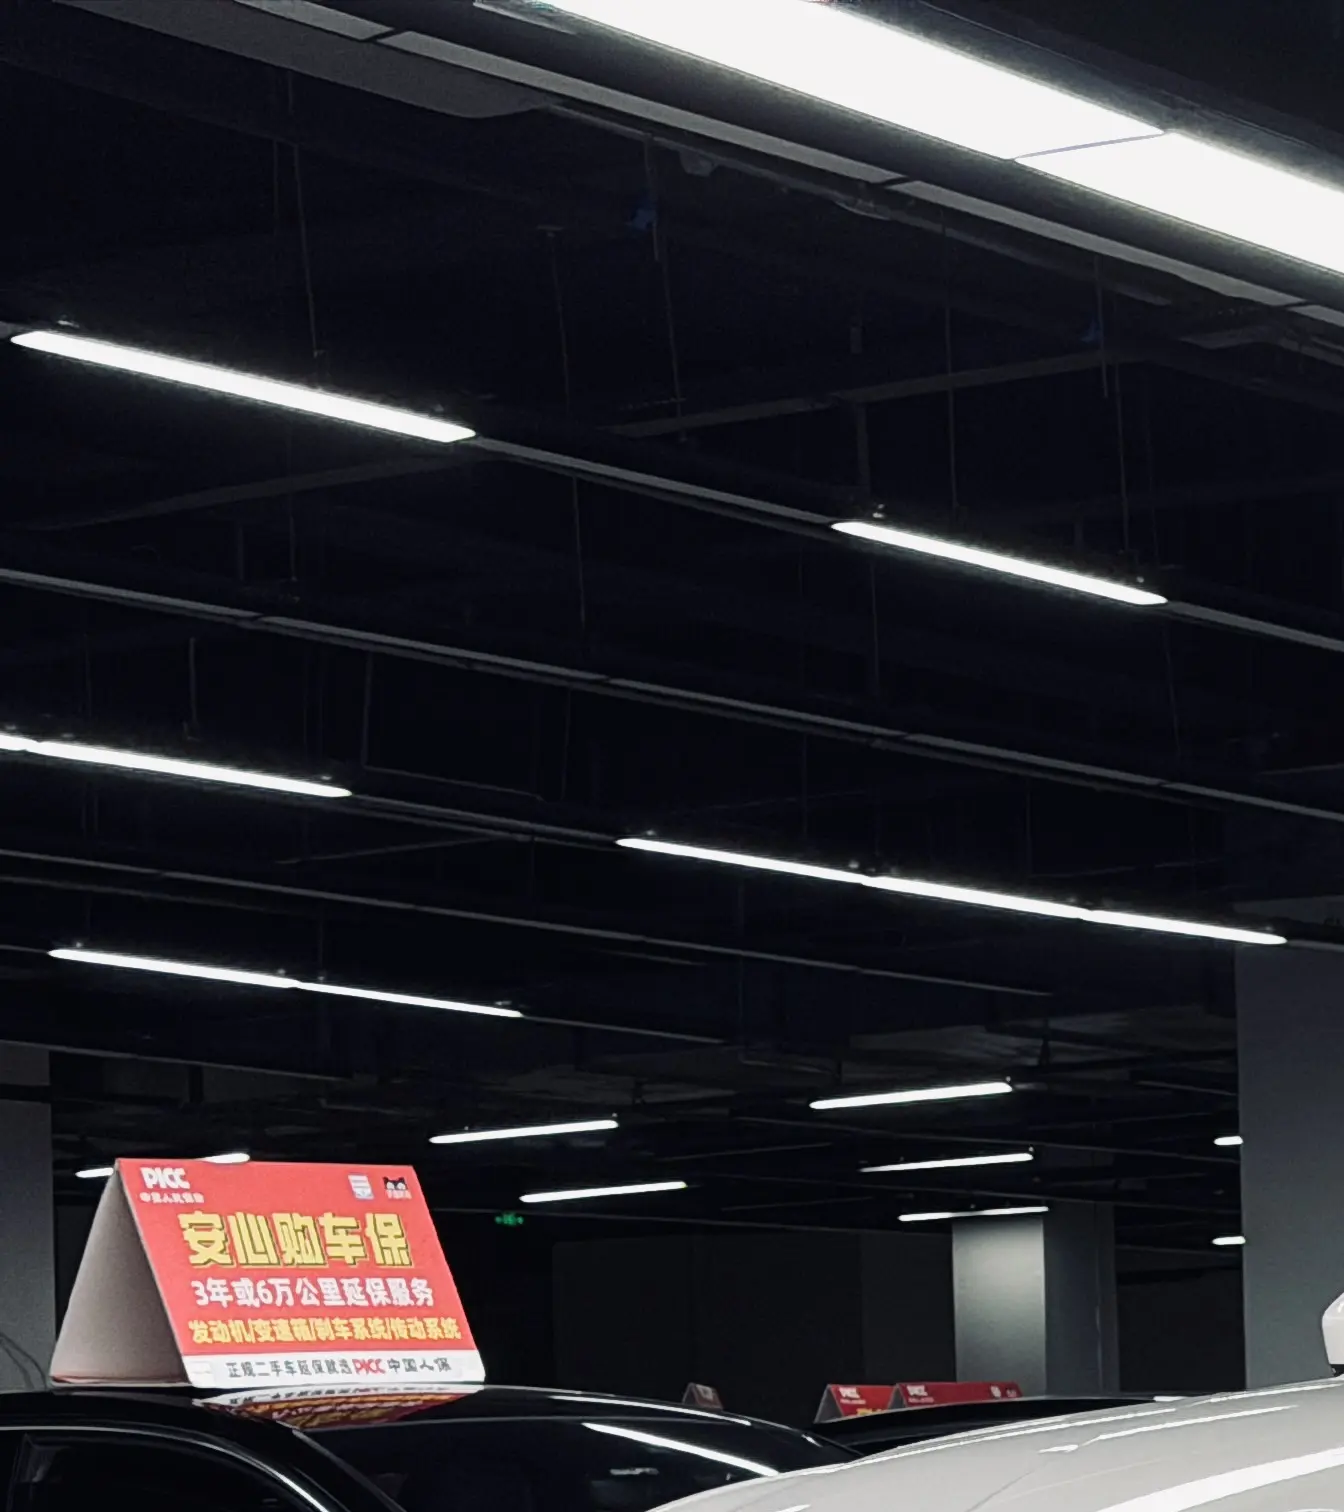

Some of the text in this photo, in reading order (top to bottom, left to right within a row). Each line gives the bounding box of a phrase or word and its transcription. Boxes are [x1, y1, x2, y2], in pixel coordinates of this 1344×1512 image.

[140, 1166, 190, 1190] PICC
[177, 1211, 413, 1267] 安心购车保
[191, 1276, 434, 1309] 3年或6万公里延保服务
